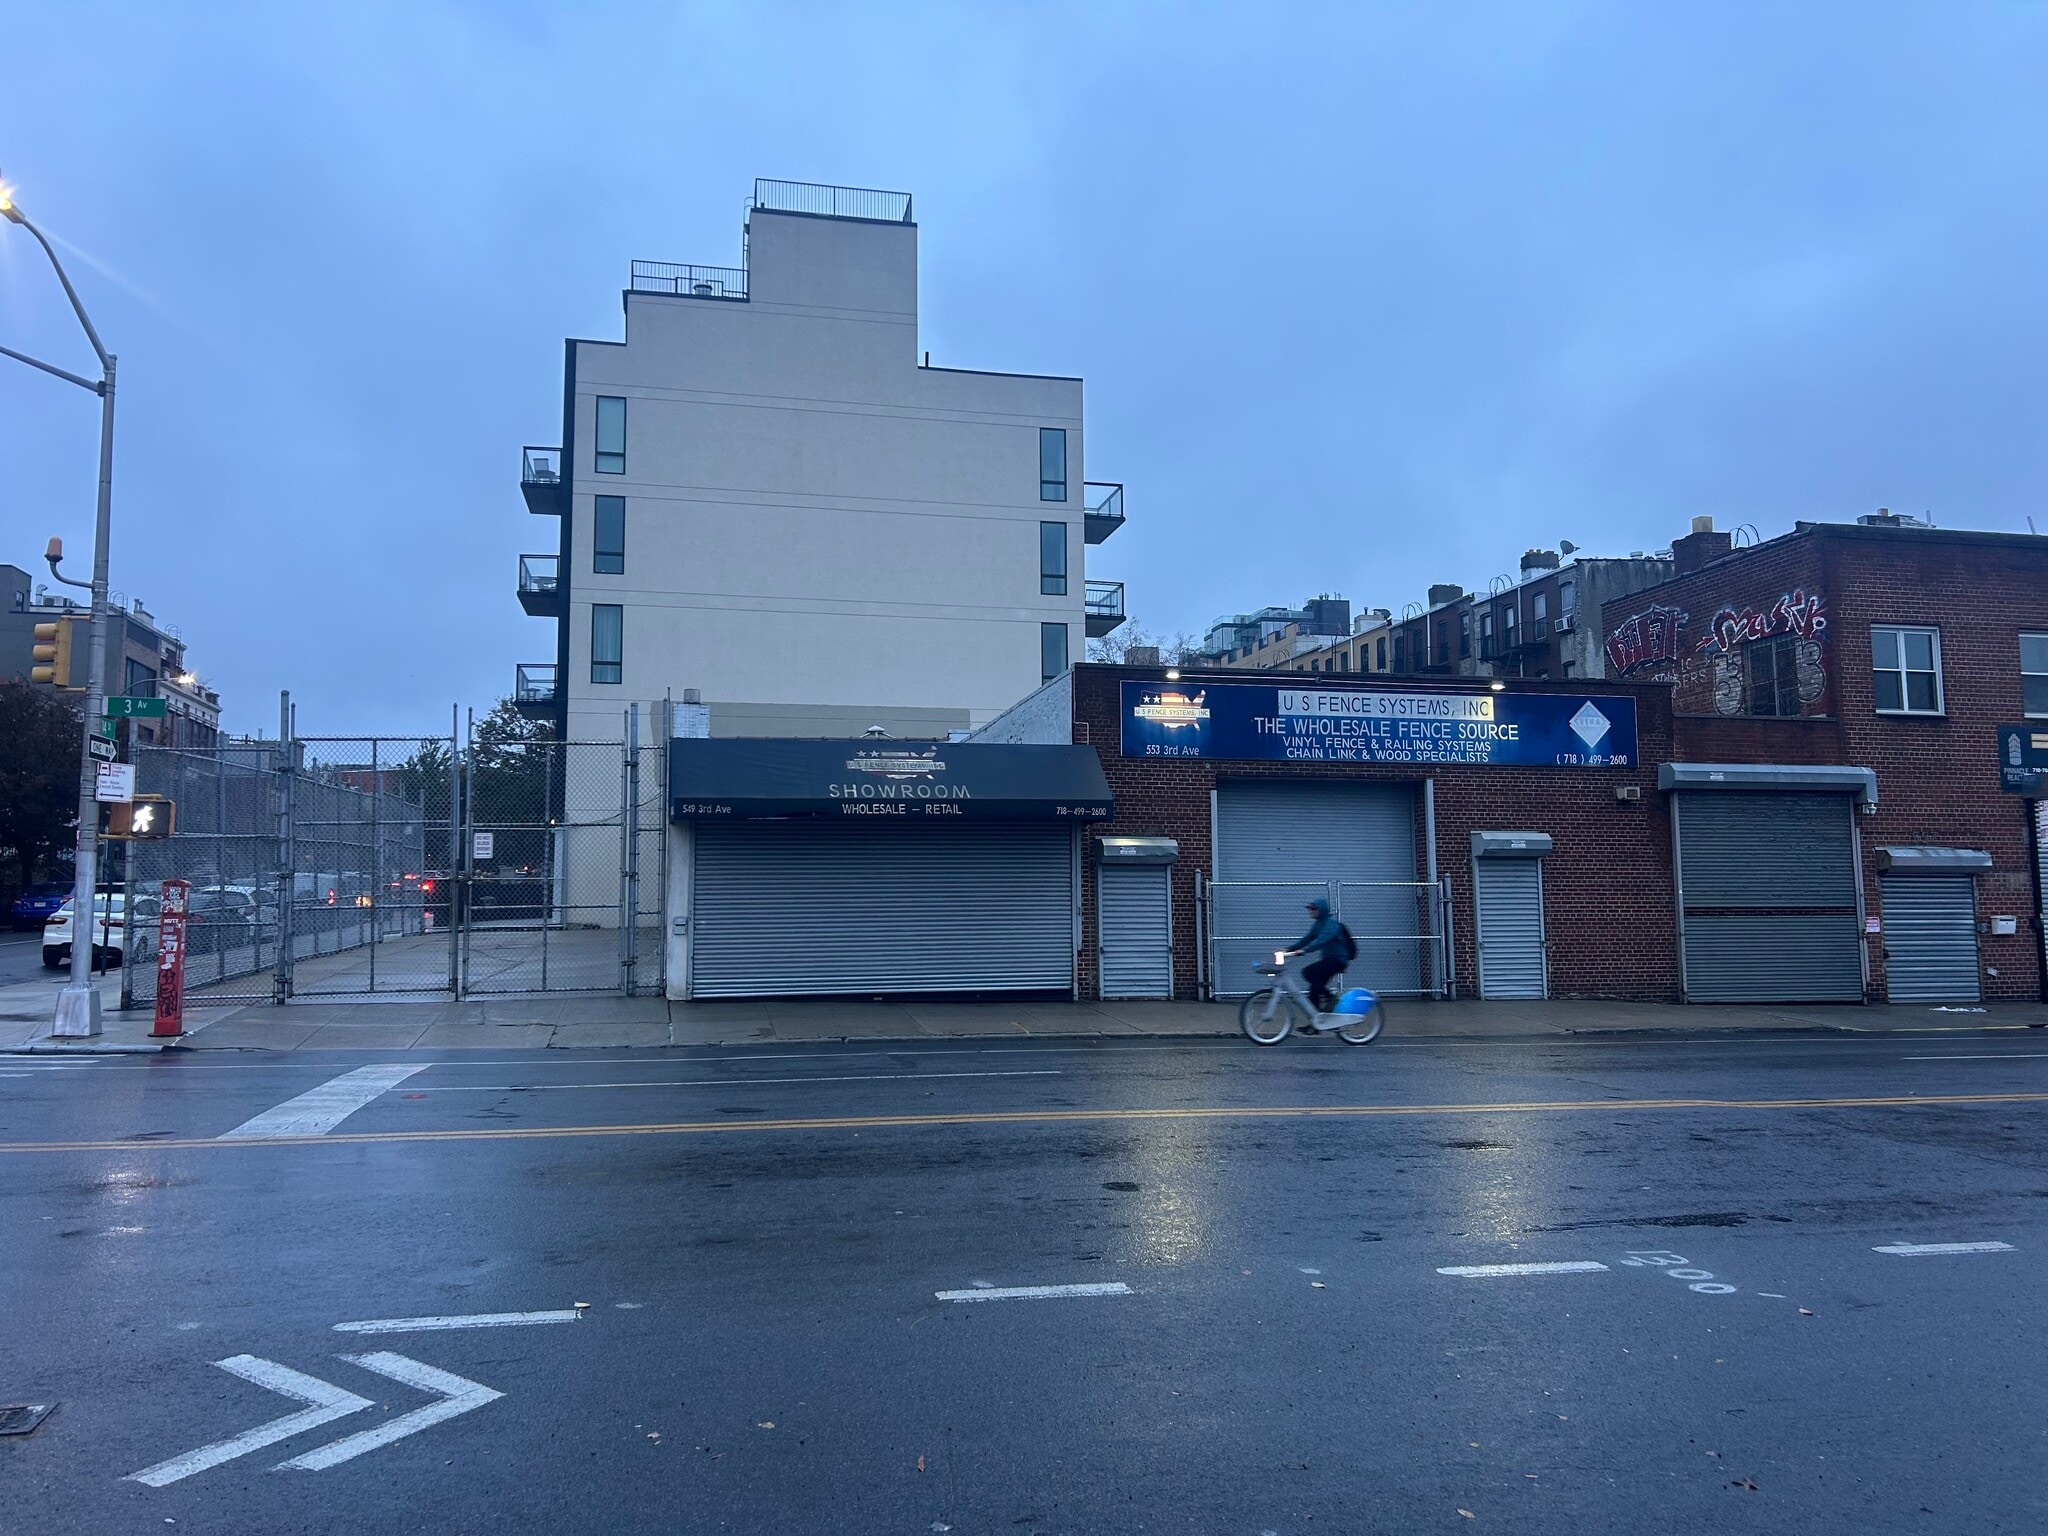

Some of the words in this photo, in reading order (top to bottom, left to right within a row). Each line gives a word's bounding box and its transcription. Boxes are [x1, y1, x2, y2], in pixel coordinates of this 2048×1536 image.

[124, 699, 132, 714] 3
[137, 700, 148, 709] Av
[1283, 695, 1293, 711] U
[1302, 696, 1310, 711] S
[1318, 696, 1371, 713] FENCE
[1379, 698, 1456, 717] SYSTEMS,
[1463, 700, 1489, 716] INC
[1254, 717, 1286, 734] THE
[1293, 718, 1391, 737] WHOLESALE
[1398, 721, 1452, 739] FENCE
[1458, 722, 1519, 740] SOURCE
[93, 742, 102, 753] ONE
[105, 746, 115, 756] WAY
[1145, 744, 1161, 755] 553
[1163, 745, 1179, 756] 3rd
[1182, 746, 1200, 756] Ave
[1283, 736, 1320, 747] VINYL
[1325, 737, 1366, 749] FENCE
[1370, 739, 1380, 749] &
[1384, 739, 1433, 750] RAILING
[1438, 740, 1492, 752] SYSTEMS
[1286, 748, 1324, 759] CHAIN
[1329, 749, 1357, 759] LINK
[1361, 750, 1371, 759] &
[1375, 750, 1412, 761] WOOD
[1416, 751, 1489, 763] SPECIALISTS
[1588, 754, 1628, 765] 499-2600
[829, 783, 971, 799] SHOWROOM
[682, 804, 696, 813] 549
[698, 804, 712, 813] 3rd
[715, 805, 732, 813] Ave
[842, 803, 906, 815] WHOLESALE
[925, 804, 963, 815] RETAIL
[1056, 806, 1107, 816] 718-499-2600
